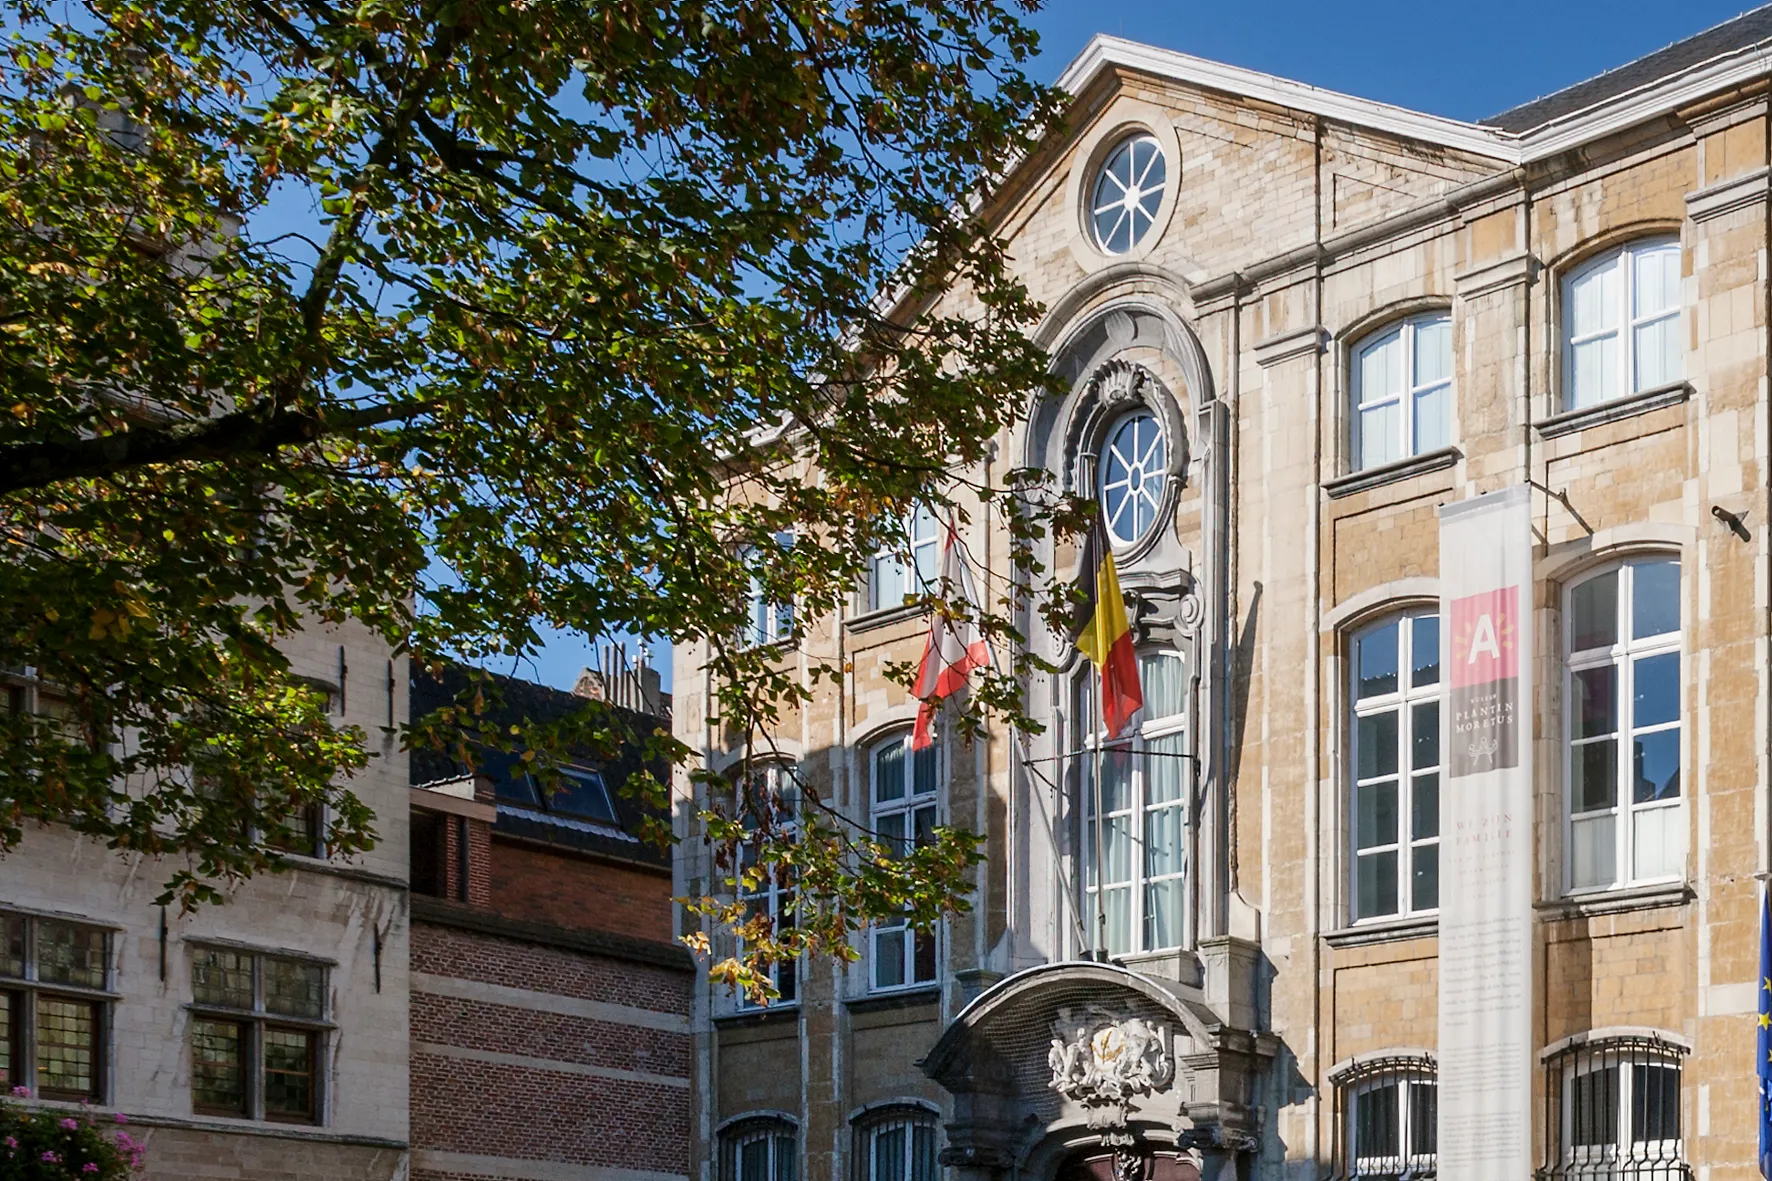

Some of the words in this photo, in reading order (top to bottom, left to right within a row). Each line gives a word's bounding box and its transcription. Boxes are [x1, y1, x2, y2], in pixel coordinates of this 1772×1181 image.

[1468, 613, 1500, 665] A
[1455, 701, 1513, 722] PLANTIN
[1455, 714, 1513, 734] MORETUS
